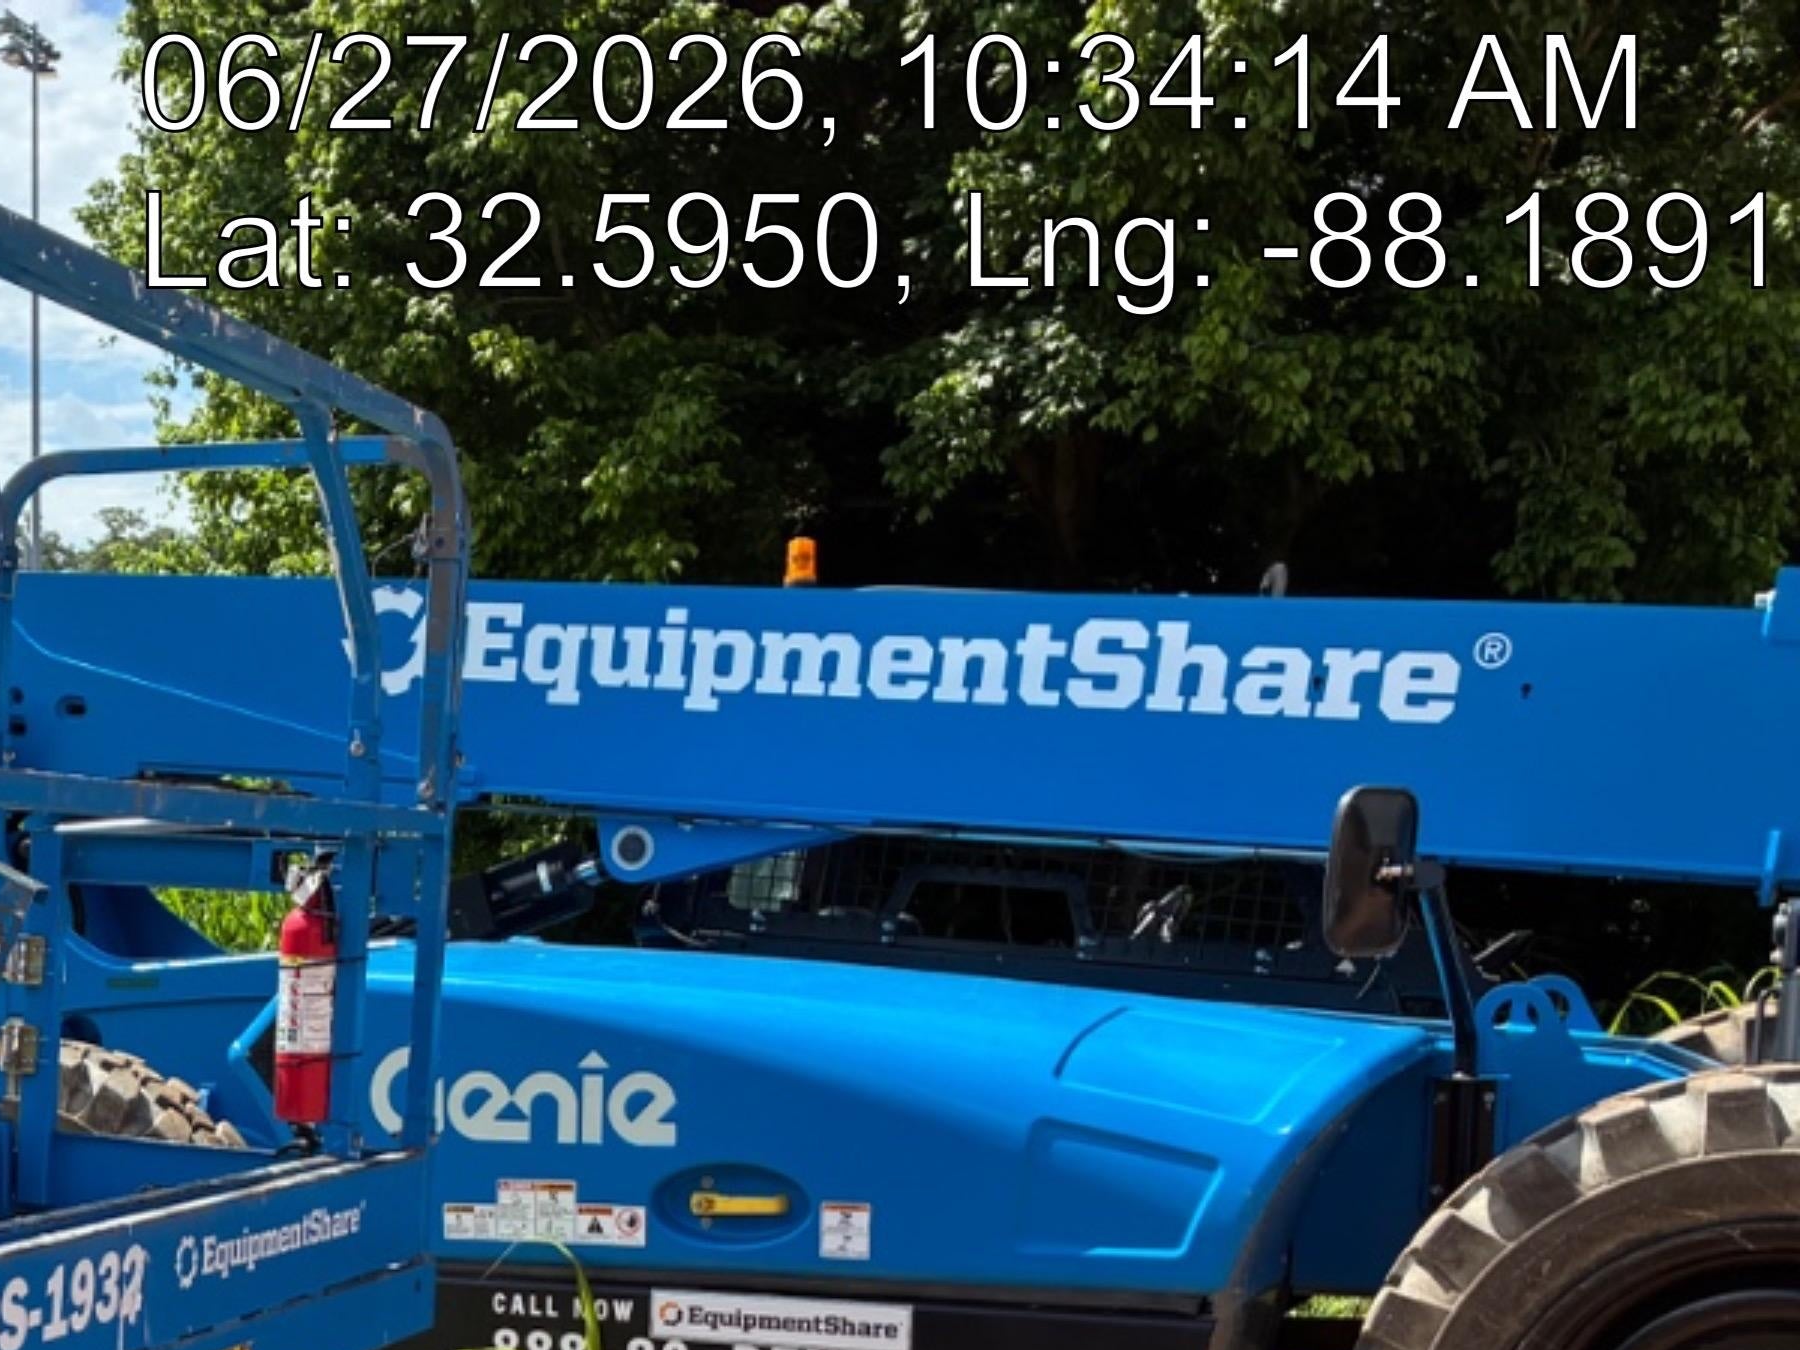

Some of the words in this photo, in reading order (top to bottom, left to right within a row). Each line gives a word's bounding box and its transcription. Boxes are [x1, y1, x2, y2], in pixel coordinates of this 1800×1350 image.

[202, 1206, 361, 1280] EquipmentShare
[491, 1291, 559, 1318] CALL
[688, 1304, 899, 1339] EquipmentShare
